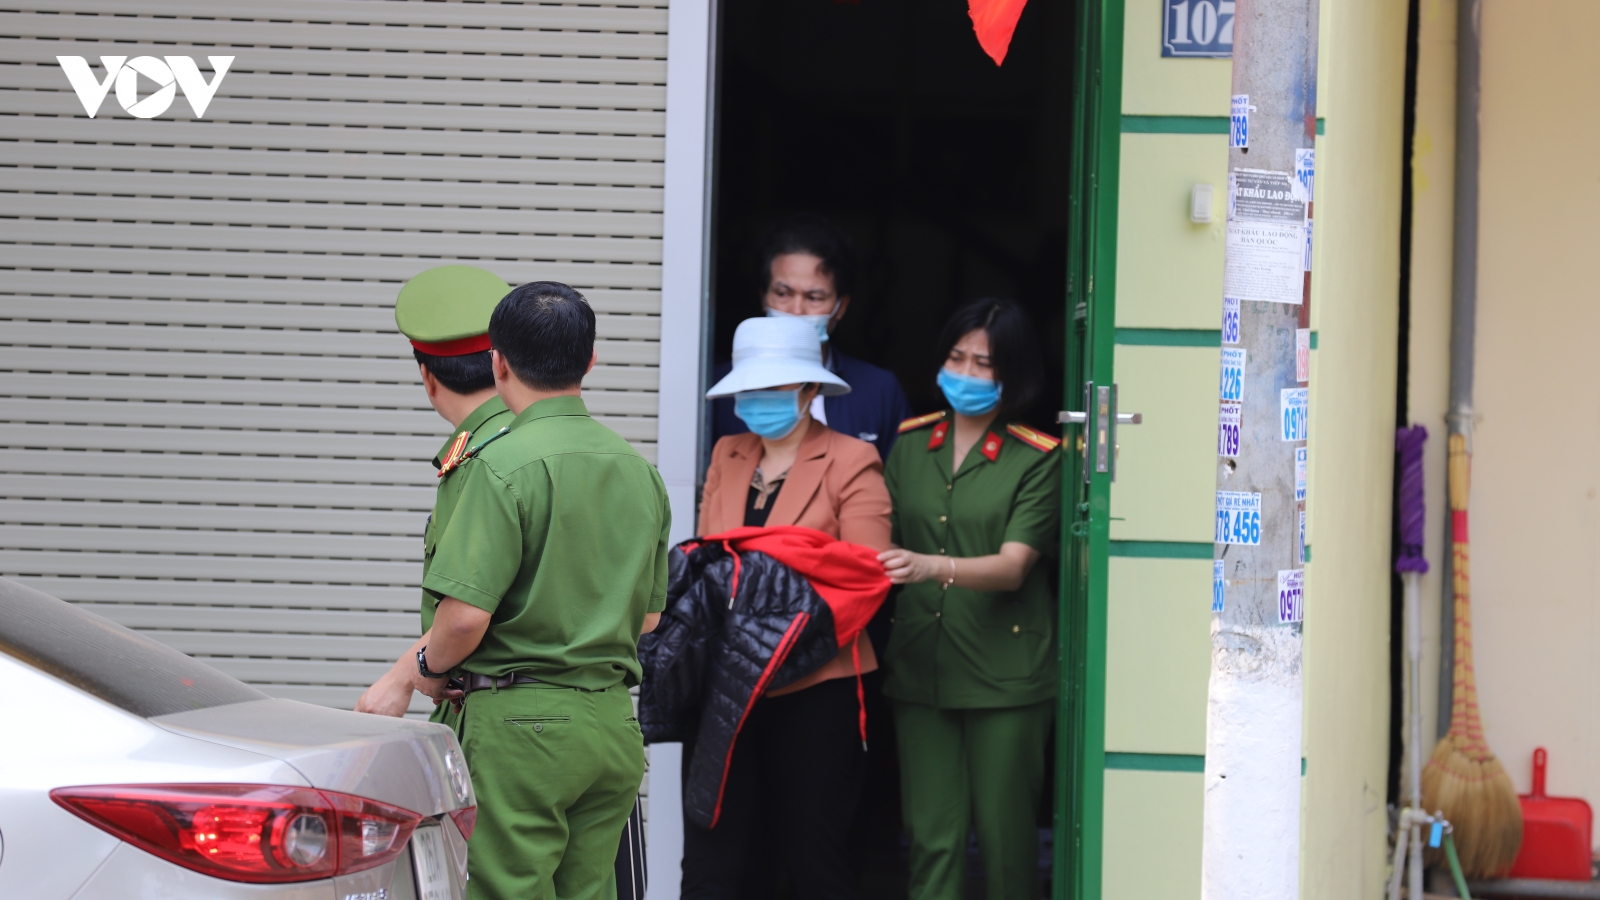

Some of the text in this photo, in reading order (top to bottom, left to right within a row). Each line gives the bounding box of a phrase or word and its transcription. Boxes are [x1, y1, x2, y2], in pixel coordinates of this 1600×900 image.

[1170, 1, 1235, 45] 107
[1267, 189, 1283, 200] LAO
[1262, 230, 1278, 238] LAO
[1279, 231, 1298, 240] ĐỘNG
